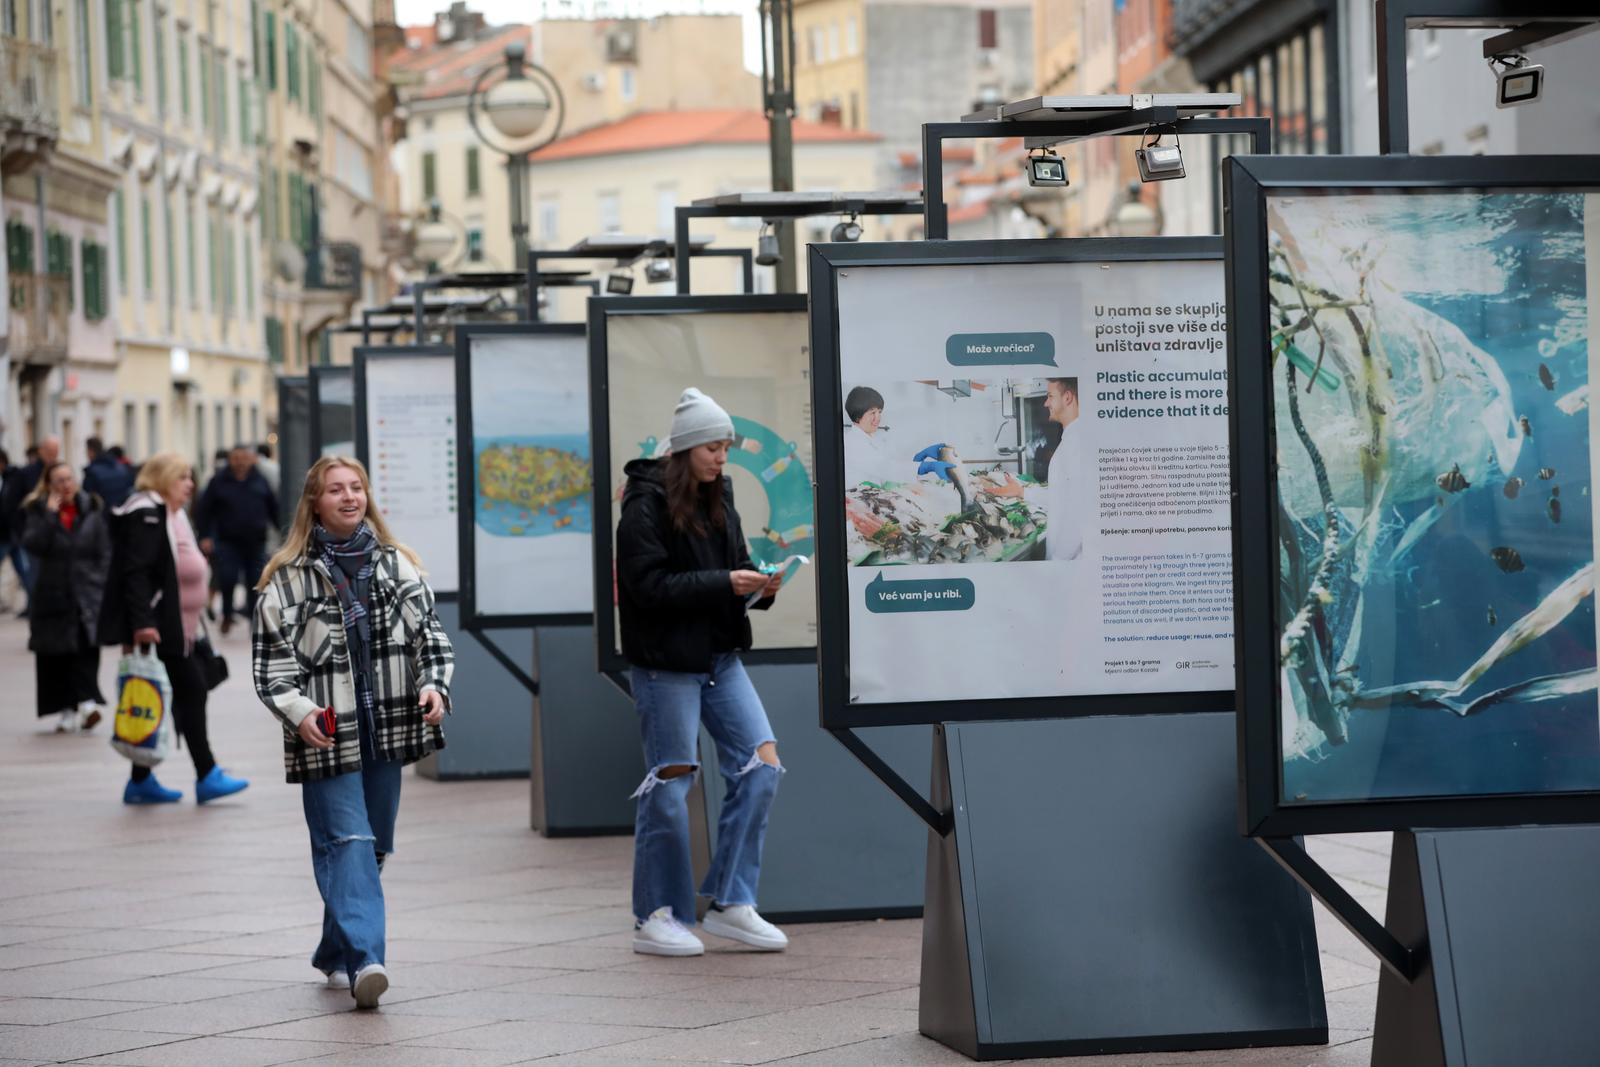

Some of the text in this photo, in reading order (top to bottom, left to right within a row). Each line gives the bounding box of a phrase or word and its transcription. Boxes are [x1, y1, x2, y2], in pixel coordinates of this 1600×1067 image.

[1094, 304, 1104, 317] U
[1108, 307, 1152, 317] nama
[1155, 306, 1172, 316] se
[1096, 322, 1145, 338] postoji
[1148, 324, 1174, 334] sve
[1177, 320, 1207, 333] više
[966, 344, 992, 354] Može
[1096, 337, 1224, 354] uništava zdravlje
[1096, 370, 1145, 384] Plastic
[1097, 387, 1224, 401] and there is more
[1098, 405, 1164, 419] evidence
[1167, 404, 1197, 417] that
[1200, 404, 1210, 416] it
[878, 591, 898, 601] Već
[923, 590, 933, 601] je
[942, 589, 962, 599] ribi.
